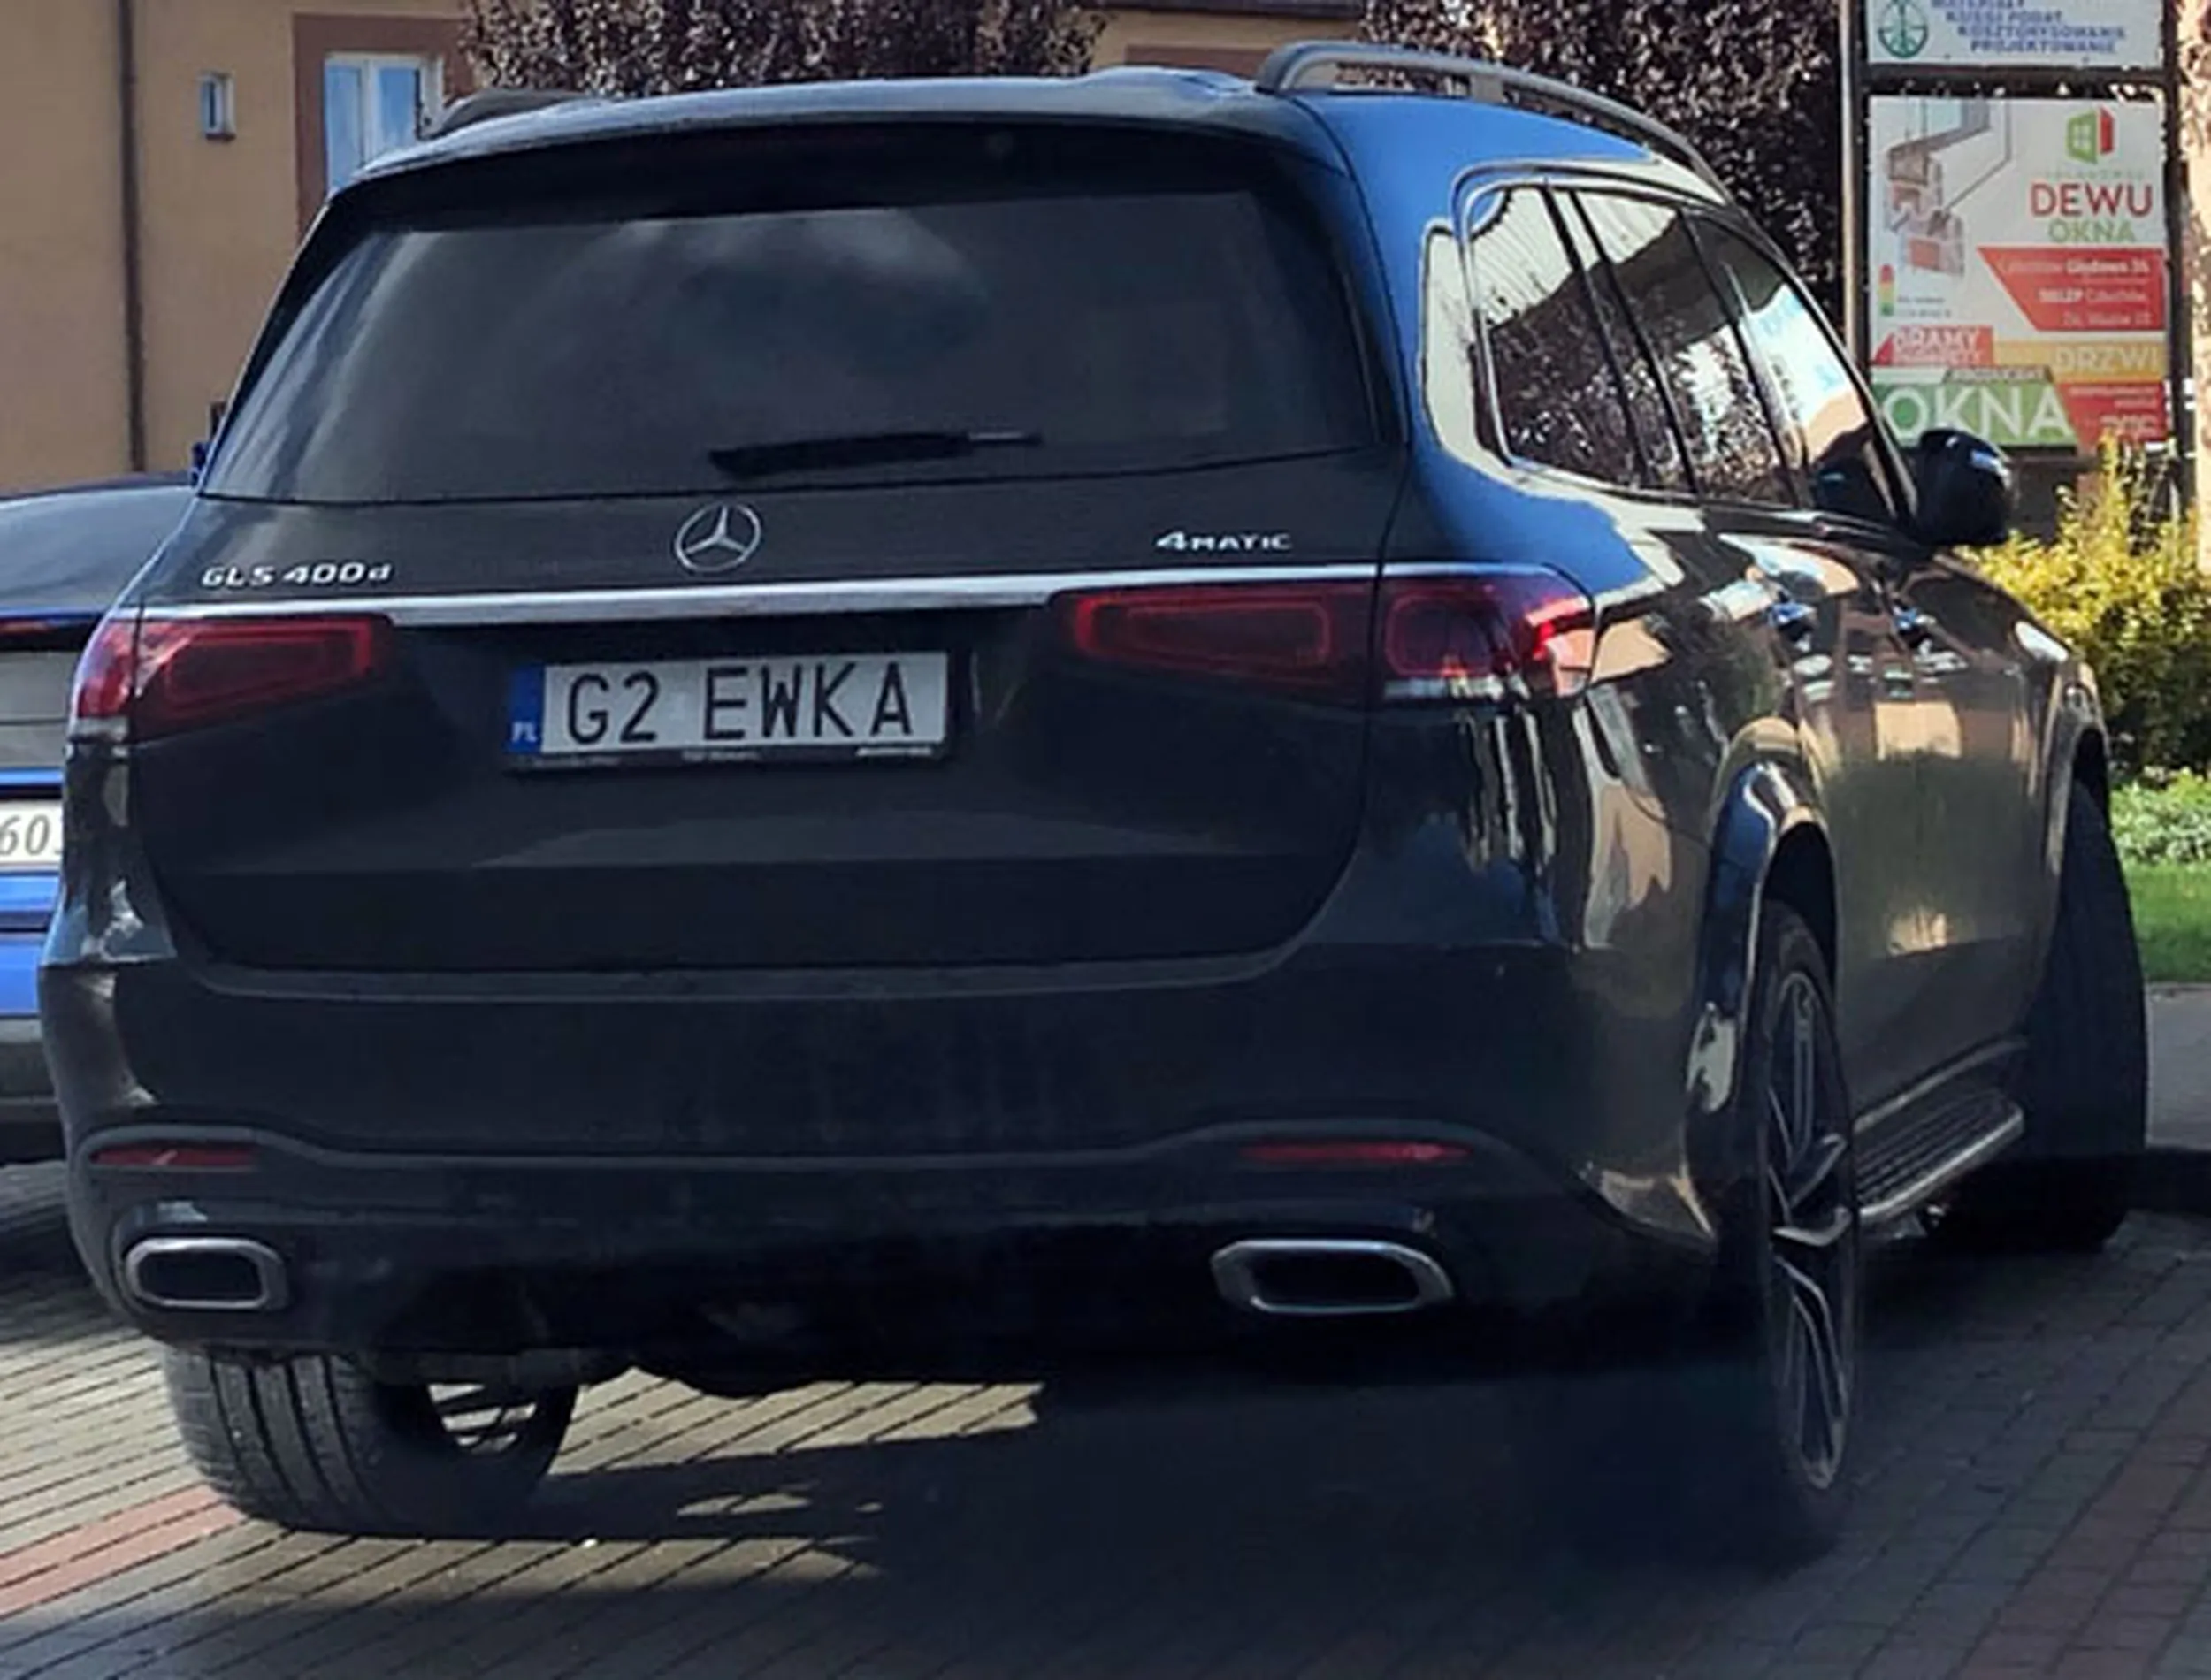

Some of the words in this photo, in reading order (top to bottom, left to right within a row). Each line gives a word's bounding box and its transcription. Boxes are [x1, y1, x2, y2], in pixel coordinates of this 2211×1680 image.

[2031, 182, 2153, 218] DEWU
[2048, 220, 2135, 243] OKNA
[2054, 345, 2158, 372] DRZWI
[1881, 386, 2077, 446] OKNA
[202, 565, 275, 587] GLS
[283, 561, 393, 584] 400d
[567, 672, 661, 745] G2
[702, 662, 913, 741] EWKA
[0, 814, 61, 857] 60
